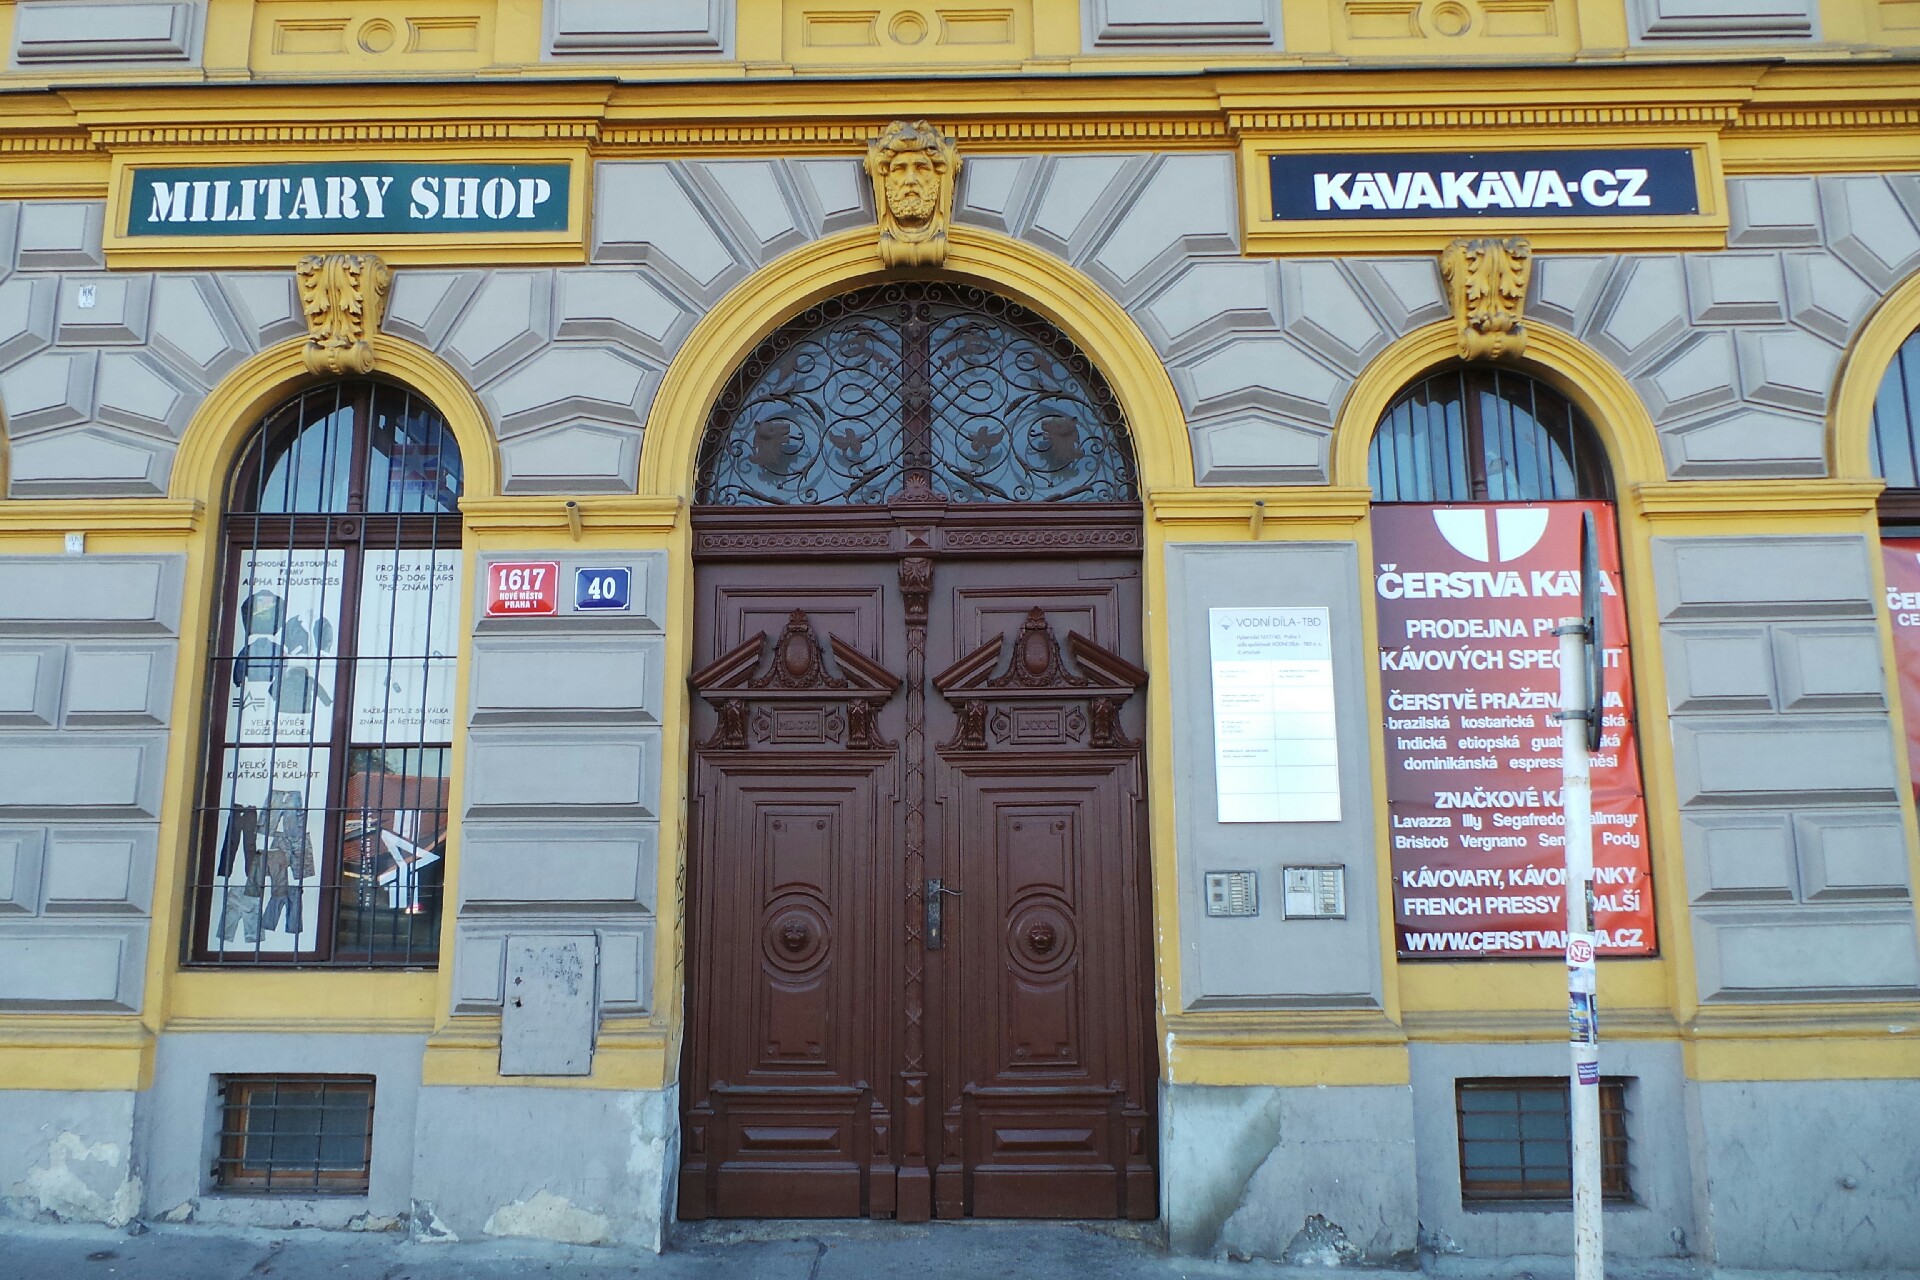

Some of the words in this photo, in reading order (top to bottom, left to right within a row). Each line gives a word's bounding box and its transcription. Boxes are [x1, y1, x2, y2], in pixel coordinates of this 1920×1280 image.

[147, 176, 394, 223] MILITARY
[409, 176, 552, 220] SHOP
[376, 564, 411, 572] PROEJ
[425, 562, 454, 572] RŽBA
[375, 574, 388, 582] US
[407, 574, 426, 582] DOG
[432, 574, 454, 582] AGS
[499, 568, 546, 591] 1617
[499, 591, 518, 600] NOVÉ
[519, 590, 543, 600] MĚSTO
[588, 577, 616, 600] 40
[504, 600, 530, 609] PRAHA
[532, 600, 538, 608] 1
[1406, 618, 1529, 639] PRODEJNA
[1381, 644, 1503, 671] KÁVOVÝCH
[1388, 688, 1478, 711] ČERSTVĚ
[1388, 715, 1451, 731] brazilská
[1461, 714, 1534, 730] kostarická
[1397, 735, 1447, 750] indická
[1458, 734, 1520, 752] etiopská
[1403, 755, 1498, 771] dominikánská
[1590, 753, 1618, 769] měsi
[1434, 786, 1540, 809] ZNAČKOVÉ
[1393, 814, 1451, 829] Lavazza
[1462, 813, 1482, 831] Illy
[1493, 812, 1565, 831] Segafredo
[1591, 811, 1639, 829] allmayr
[1396, 835, 1449, 850] Bristot
[1460, 834, 1527, 852] Vergnano
[1603, 832, 1640, 848] Pody
[1402, 866, 1505, 889] KÁVOVARY,
[1404, 896, 1482, 916] FRENCH
[1485, 895, 1560, 915] PRESSY
